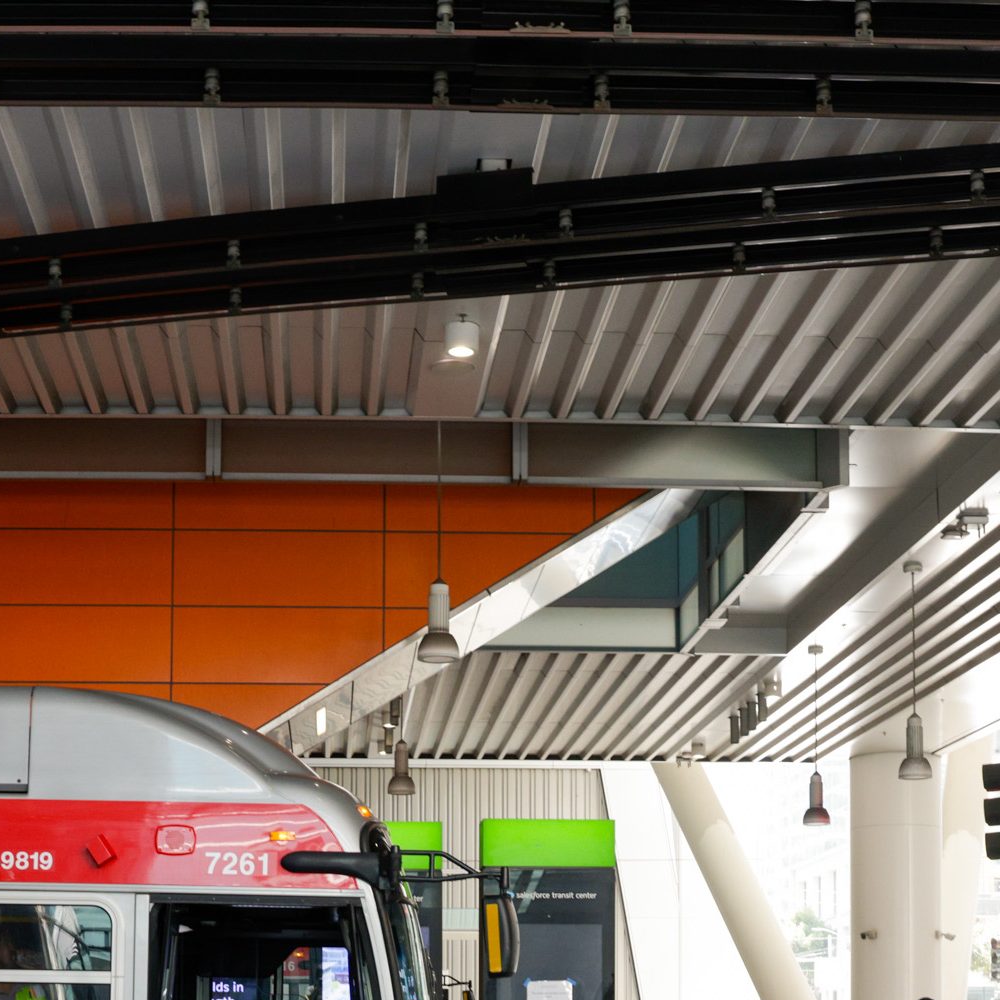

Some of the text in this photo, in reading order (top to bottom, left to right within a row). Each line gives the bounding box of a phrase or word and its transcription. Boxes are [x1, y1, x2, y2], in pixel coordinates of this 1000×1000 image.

[204, 851, 269, 876] 7261
[516, 892, 550, 900] salesforce
[233, 981, 245, 993] in
